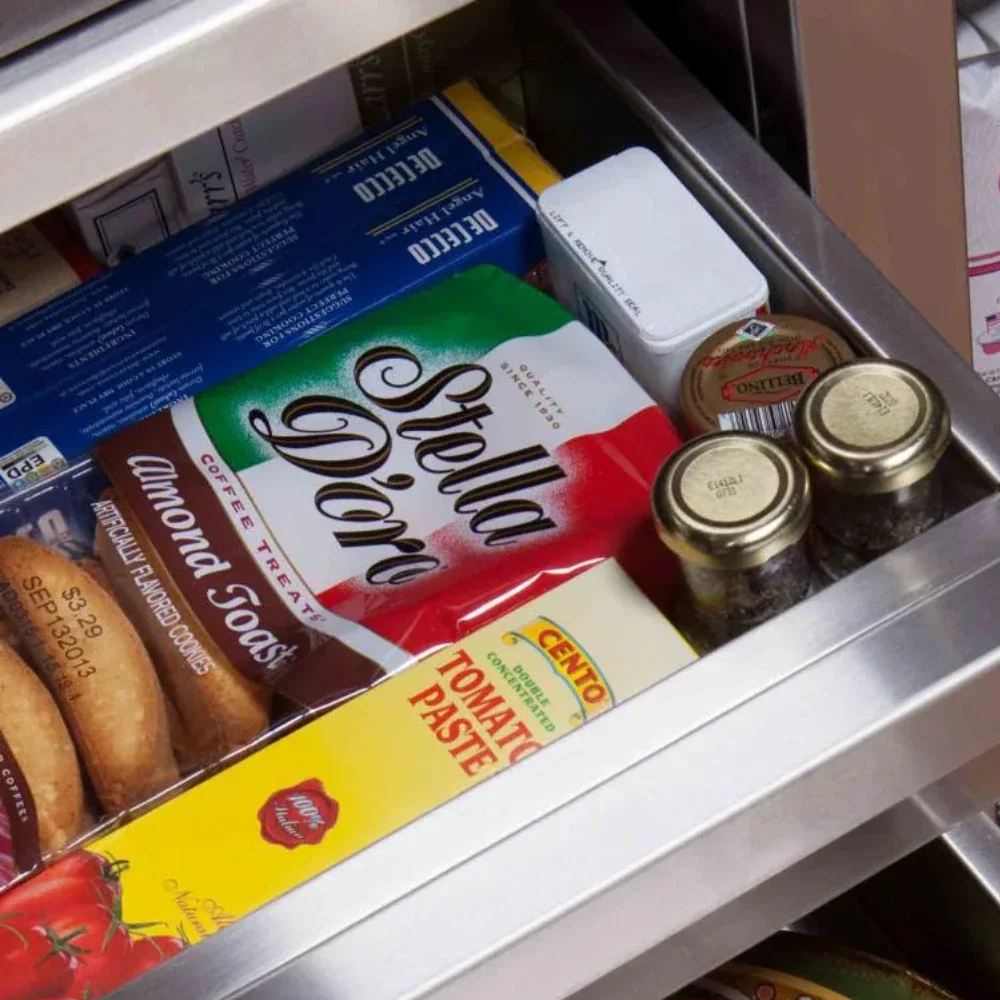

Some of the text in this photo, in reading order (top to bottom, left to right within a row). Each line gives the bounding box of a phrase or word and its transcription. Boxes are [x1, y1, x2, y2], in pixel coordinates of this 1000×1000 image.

[346, 126, 428, 173] Angel Hair
[401, 187, 484, 235] Angel Hair
[252, 286, 349, 343] PERFECT COOKING
[260, 293, 354, 349] SUGGESTIONS FOR
[65, 327, 137, 370] INGREDIENTS
[498, 360, 534, 398] SINCE
[7, 454, 44, 480] EPD
[355, 345, 566, 547] Stella
[201, 453, 255, 531] COFFEE
[91, 498, 215, 677] ARTIFICIALLY FLAVORED COOKIES
[127, 453, 214, 581] Almond
[207, 582, 296, 672] Toast
[20, 573, 96, 680] SEP132013
[60, 584, 104, 641] $3.29
[486, 651, 556, 732] CONCENTRATED
[512, 664, 551, 706] DOUBLE
[540, 627, 607, 700] CENTO
[407, 682, 499, 778] PASTE
